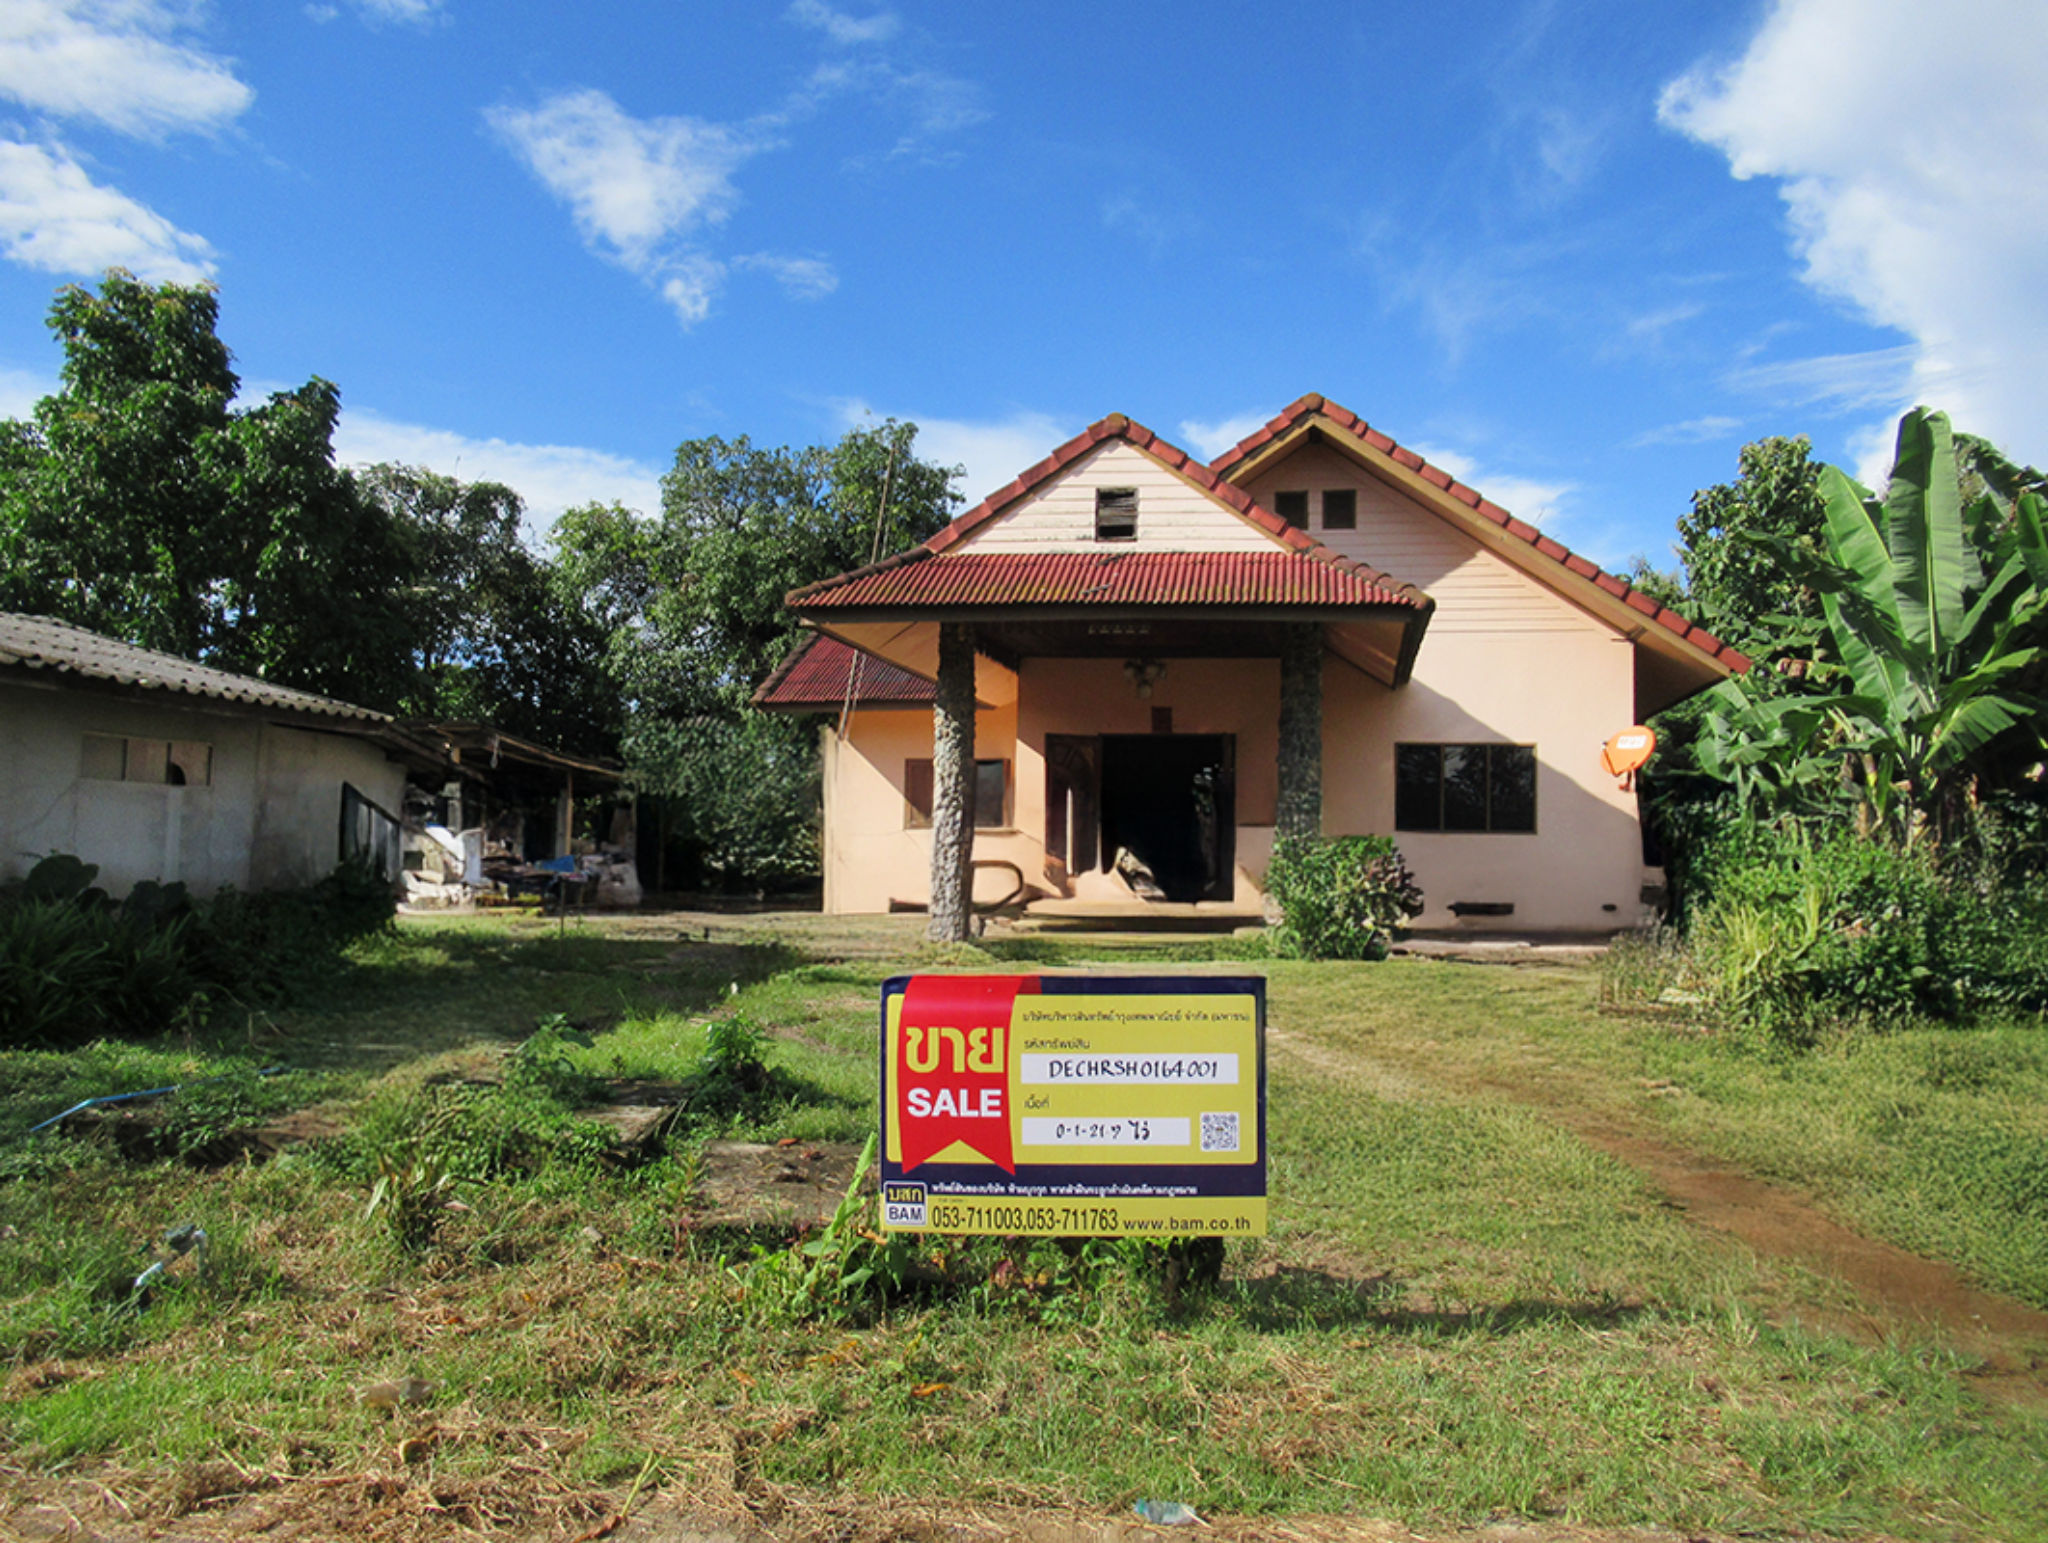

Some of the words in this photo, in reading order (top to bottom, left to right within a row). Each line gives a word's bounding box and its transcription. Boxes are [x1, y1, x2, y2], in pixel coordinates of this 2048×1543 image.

[906, 1027, 1004, 1073] ขาย
[907, 1087, 1003, 1118] SALE
[888, 1187, 923, 1202] บสก
[889, 1206, 923, 1221] BAM
[1123, 1216, 1251, 1231] www.bam.co.th
